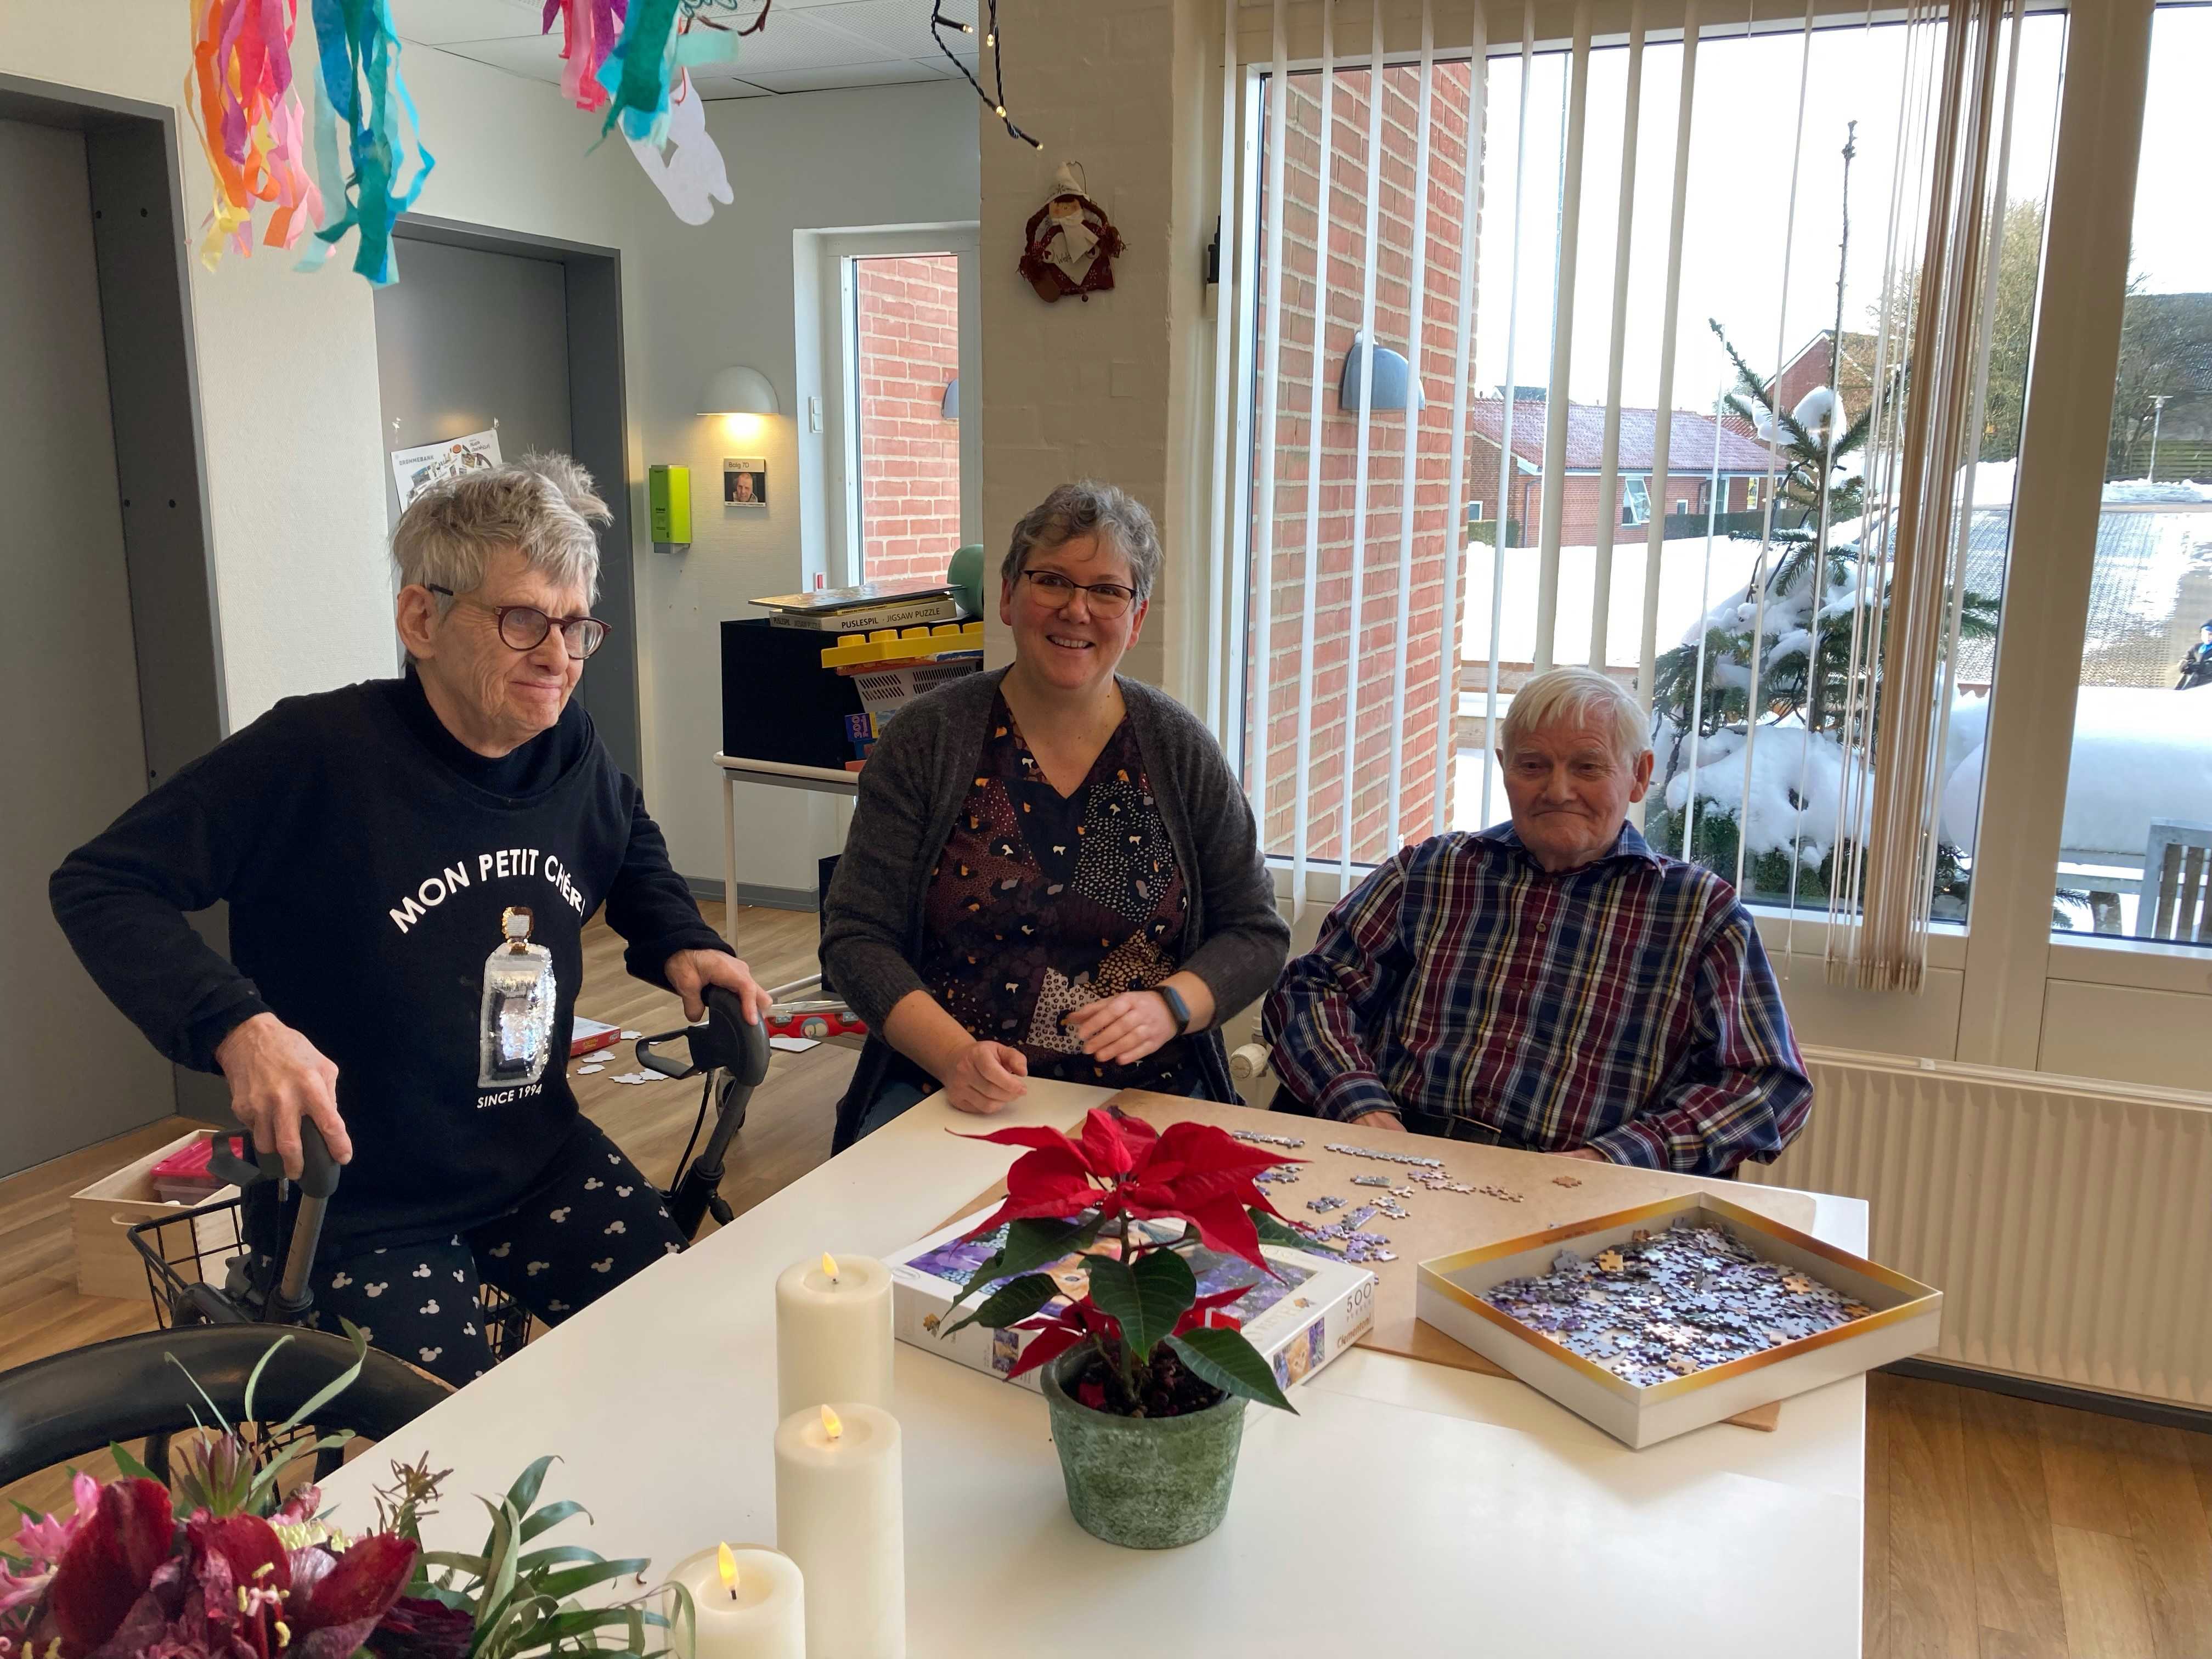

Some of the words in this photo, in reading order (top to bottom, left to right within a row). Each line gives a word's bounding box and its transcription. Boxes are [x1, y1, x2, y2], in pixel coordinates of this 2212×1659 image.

[842, 617, 879, 629] PUSLESPIL
[887, 612, 913, 623] JIGSAW
[915, 607, 940, 618] PUZZLE
[389, 861, 470, 934] MON
[478, 848, 539, 882] PETIT
[477, 1090, 515, 1109] SINCE
[518, 1084, 543, 1099] 1994
[1347, 1282, 1372, 1313] 500
[1337, 1312, 1372, 1348] Clementoni
